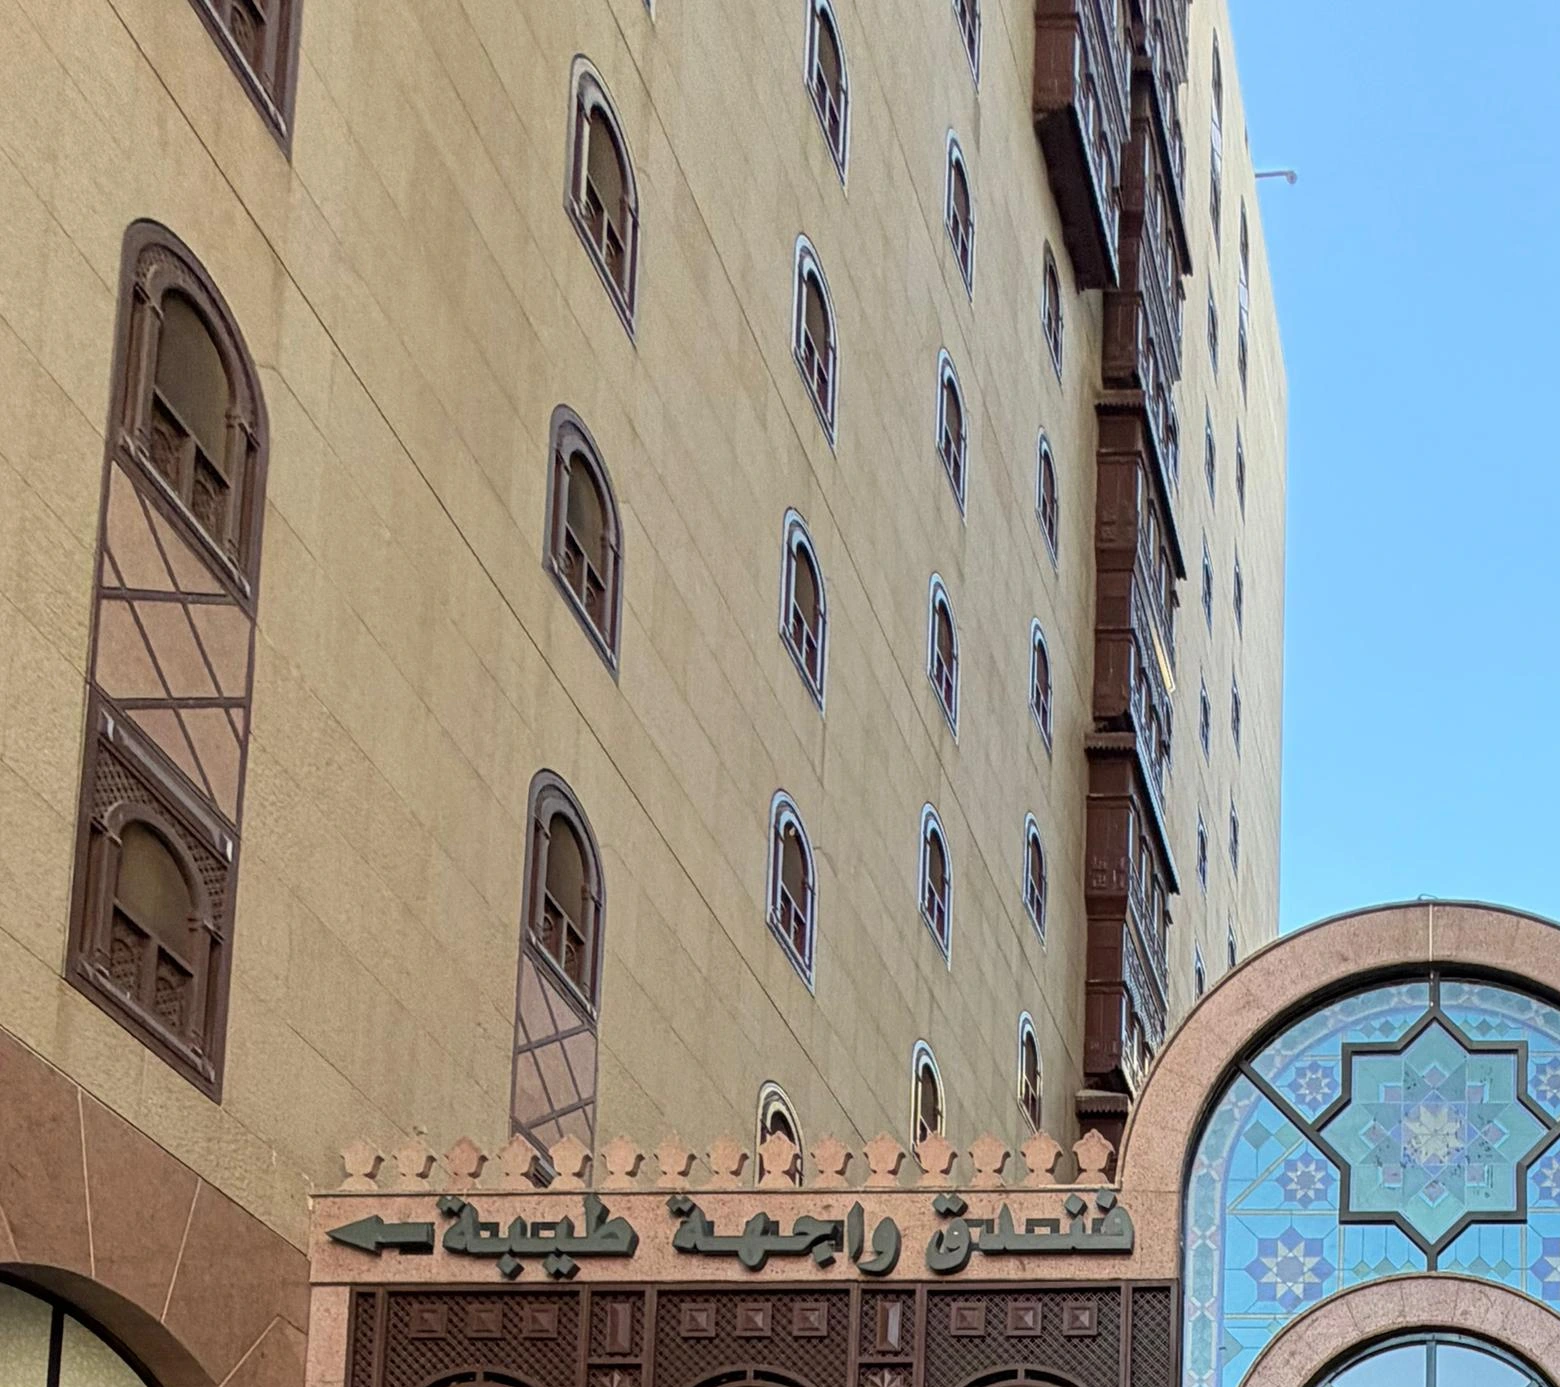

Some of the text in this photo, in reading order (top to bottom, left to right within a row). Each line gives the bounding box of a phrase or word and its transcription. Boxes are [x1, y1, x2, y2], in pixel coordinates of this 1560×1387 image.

[436, 1189, 1135, 1280] فندق واجهة طيبة
